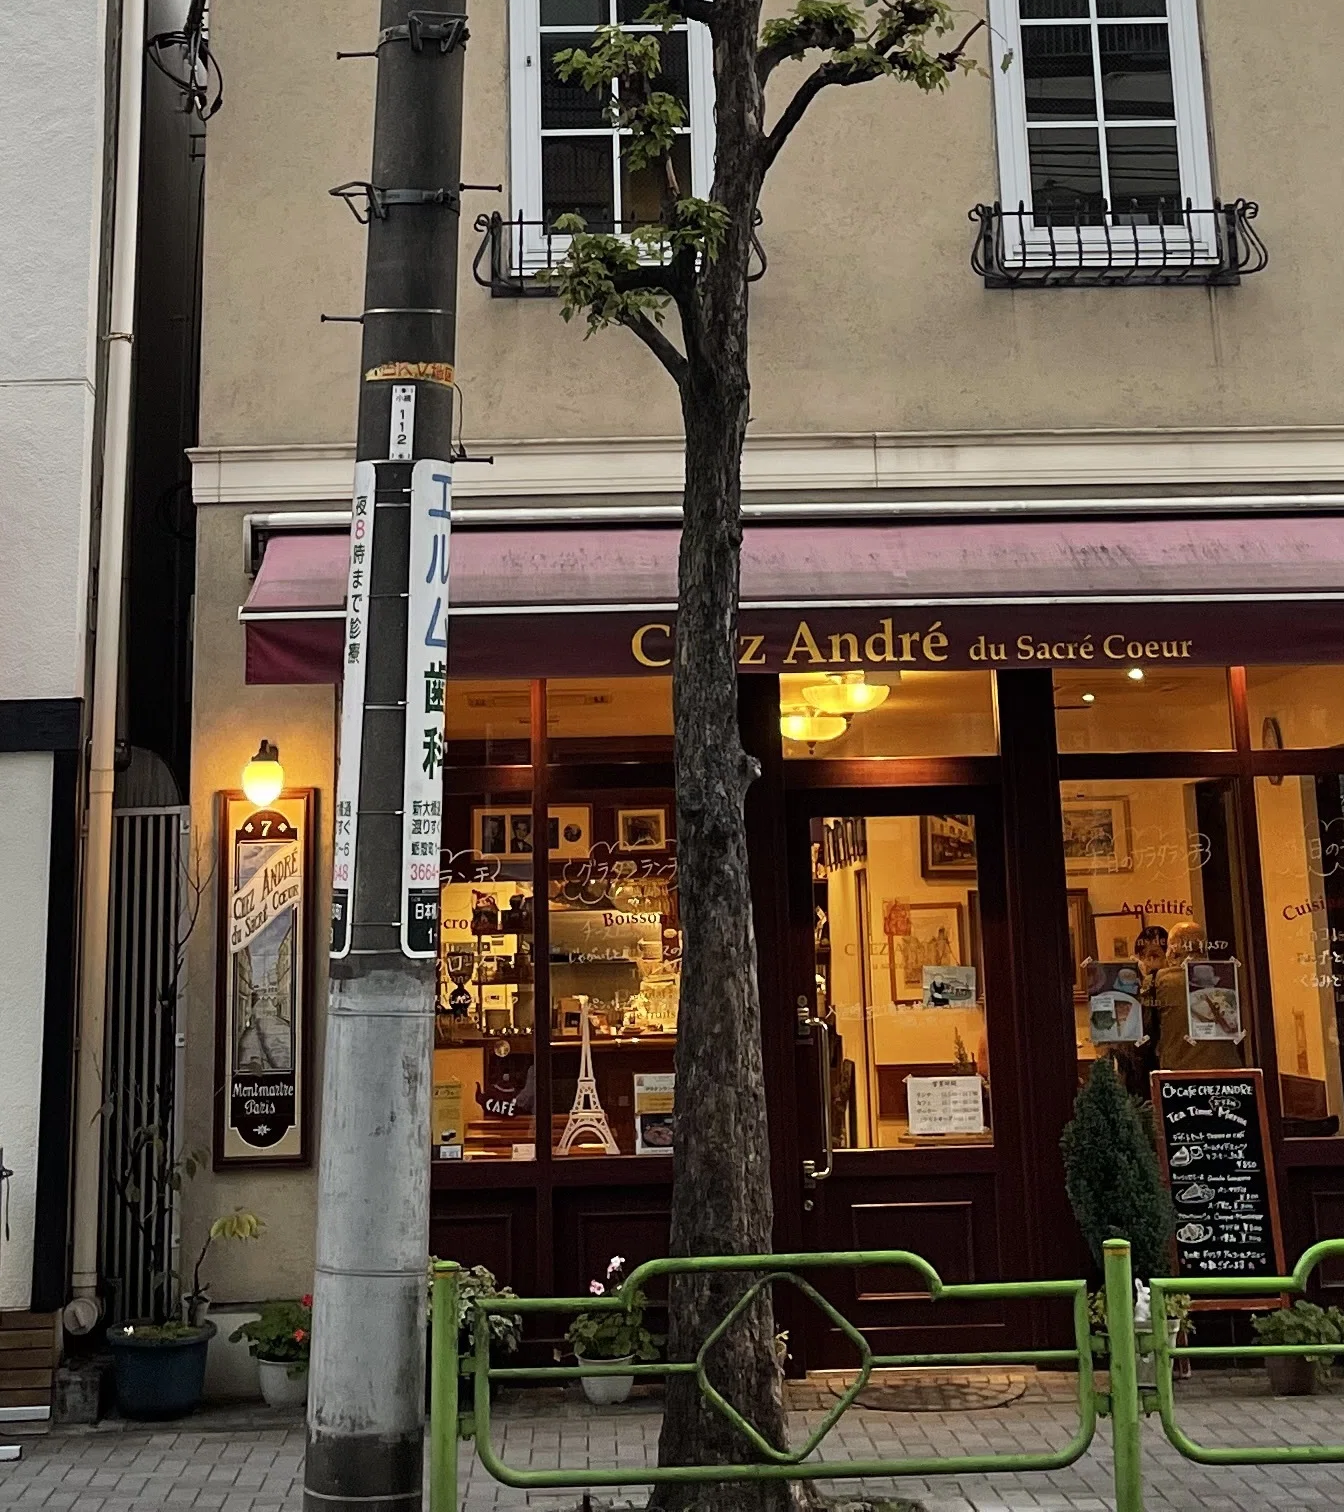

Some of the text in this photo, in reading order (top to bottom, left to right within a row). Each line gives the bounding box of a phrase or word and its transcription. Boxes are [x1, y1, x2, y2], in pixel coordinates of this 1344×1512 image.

[631, 618, 1193, 668] Cz André du Sacré Coeur
[260, 820, 272, 837] 7
[1121, 898, 1194, 920] Apéritifs
[232, 1082, 294, 1097] Montmartre
[244, 1099, 276, 1115] Paris
[485, 1097, 517, 1117] CAFÉ
